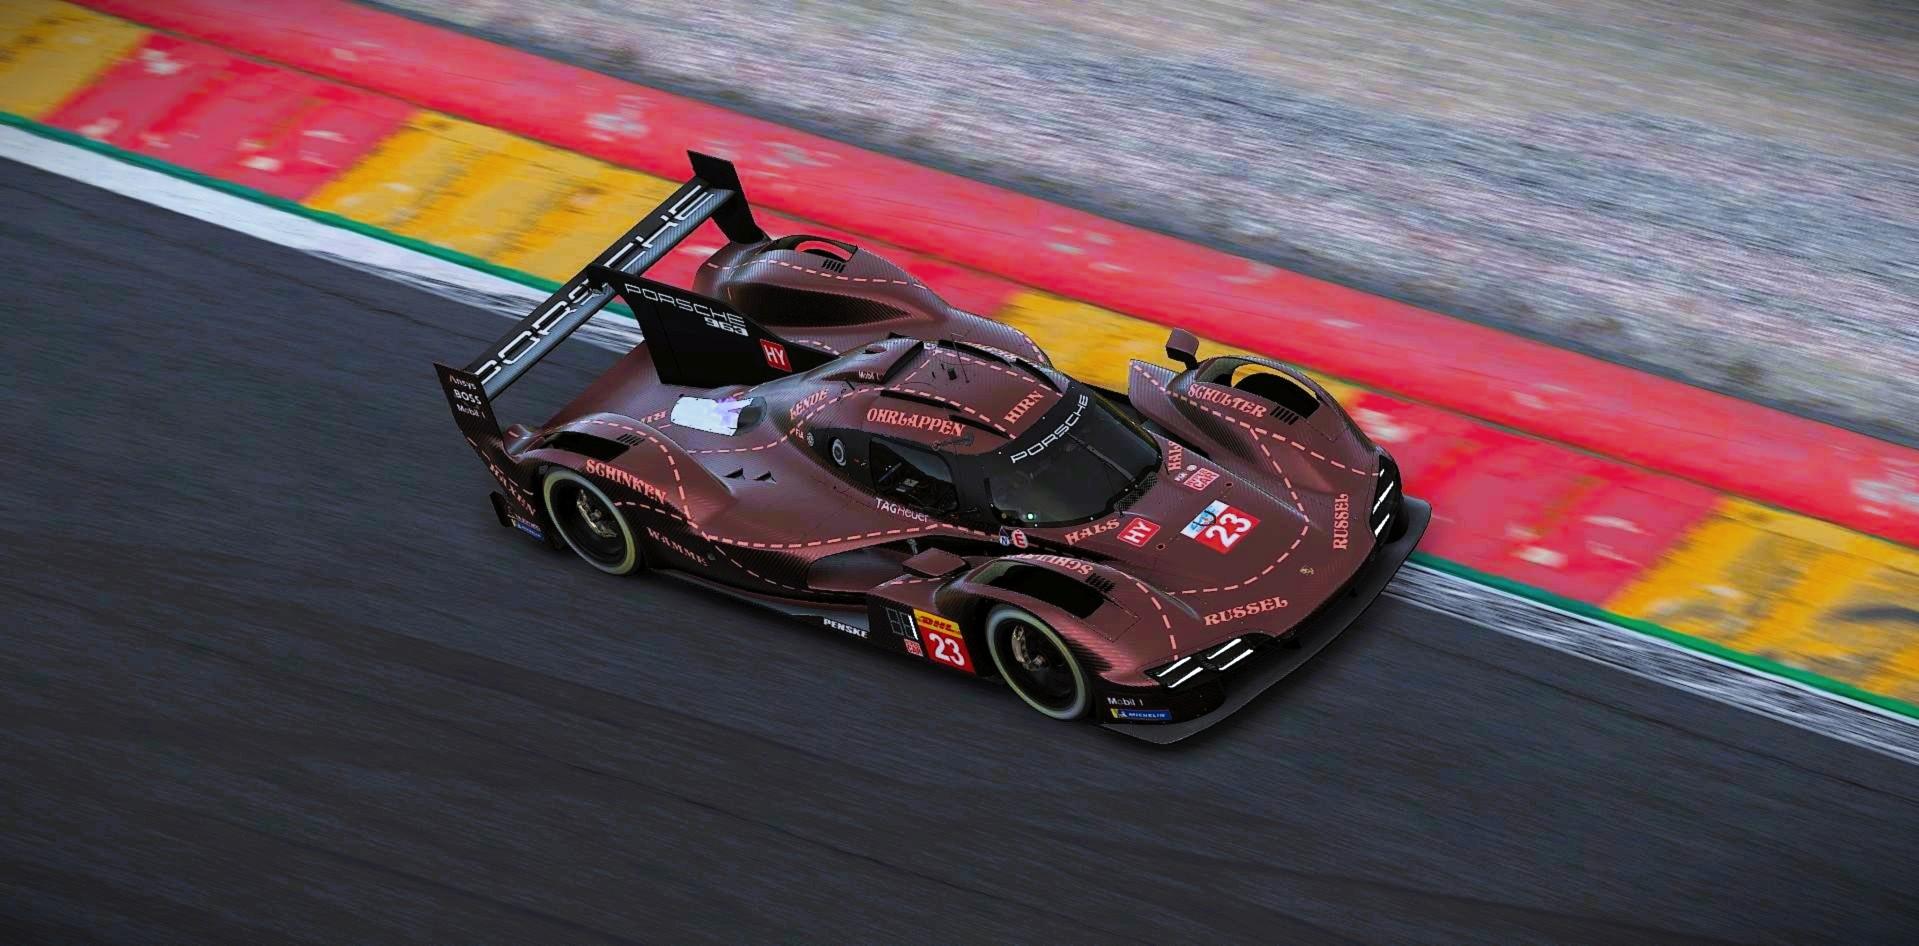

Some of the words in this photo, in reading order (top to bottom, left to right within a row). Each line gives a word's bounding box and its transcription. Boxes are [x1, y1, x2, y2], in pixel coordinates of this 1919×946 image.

[624, 282, 746, 325] PORSCHE
[706, 316, 749, 336] 963
[764, 345, 787, 367] HY
[453, 389, 482, 405] BOSS
[456, 404, 480, 417] Mobil
[1003, 390, 1045, 424] HIRN
[1188, 383, 1268, 418] SCHULTER
[866, 408, 966, 437] OHRLAPPEN
[1010, 394, 1089, 464] PORSCHE
[586, 459, 667, 505] SCHINKEN
[1064, 518, 1120, 545] HALS
[1124, 521, 1151, 544] HY
[1204, 513, 1252, 548] 23
[1333, 493, 1349, 550] RUSSEL
[920, 616, 955, 632] DHL
[1204, 596, 1289, 626] RUSSEL
[823, 617, 868, 639] PENSKE
[928, 632, 965, 666] 23
